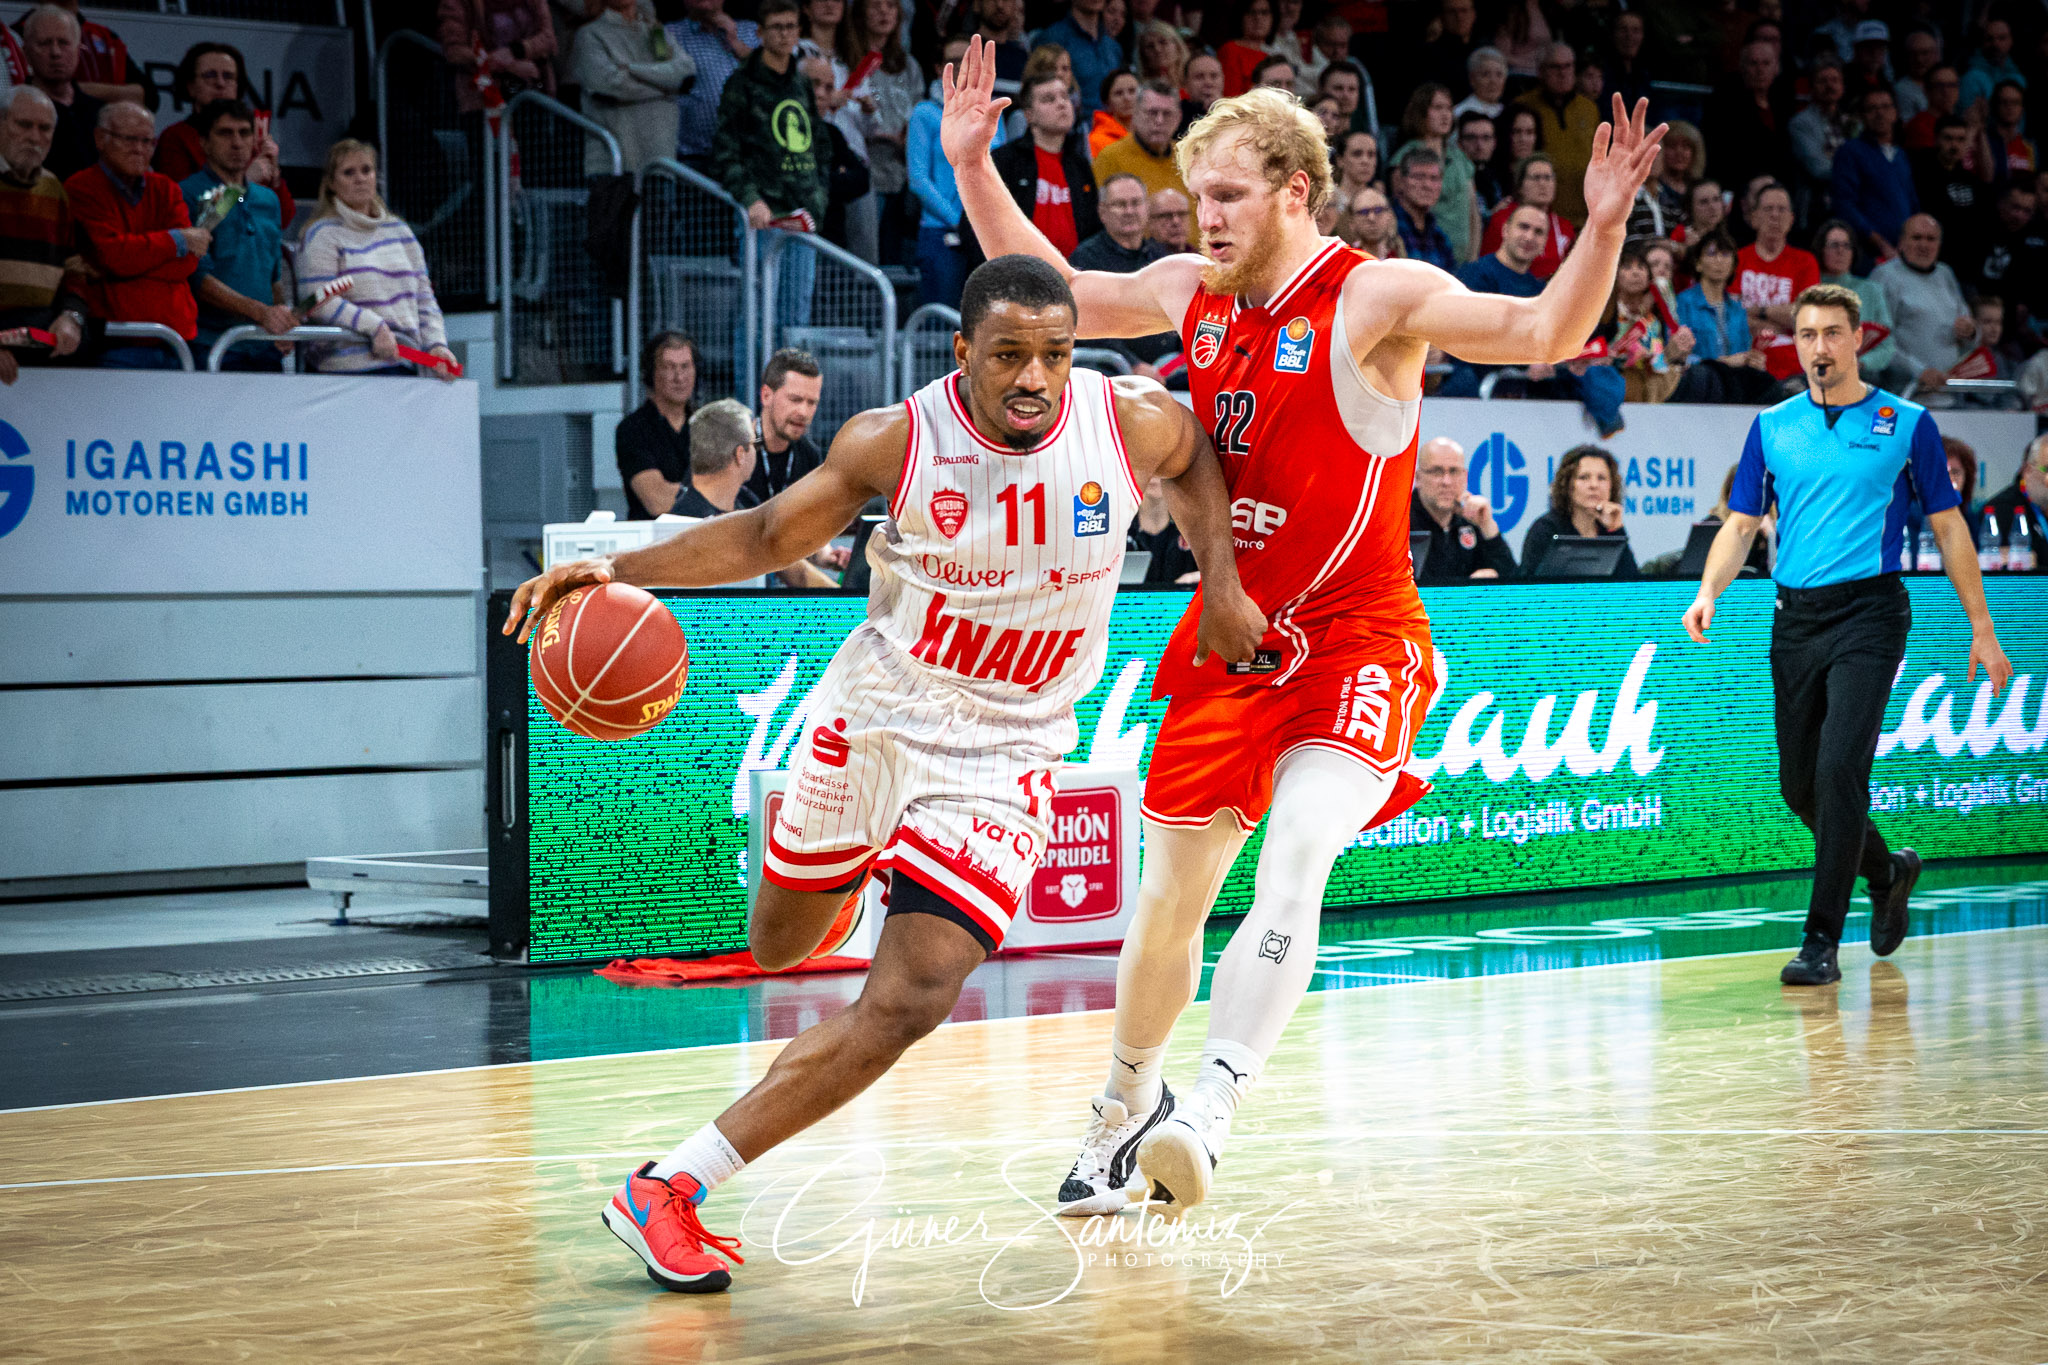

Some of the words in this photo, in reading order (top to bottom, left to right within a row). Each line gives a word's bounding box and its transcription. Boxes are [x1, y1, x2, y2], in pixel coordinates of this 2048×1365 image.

[1278, 354, 1303, 368] BBL
[1214, 390, 1256, 455] 22
[65, 439, 308, 481] IGARASHI
[932, 454, 979, 466] SPALDING
[1548, 456, 1695, 488] IASHI
[65, 490, 214, 516] MOTOREN
[224, 491, 308, 516] GMBH
[996, 482, 1046, 546] 11
[1642, 495, 1695, 516] GMBH
[1077, 519, 1106, 533] BBL
[909, 591, 1086, 694] KNAUF
[1257, 654, 1271, 664] XL
[801, 766, 849, 790] Sparkasse
[1049, 806, 1110, 844] RHÖN
[1482, 800, 1575, 844] Logistik
[1580, 795, 1662, 830] GmbH
[1038, 845, 1111, 869] SPRUDEL
